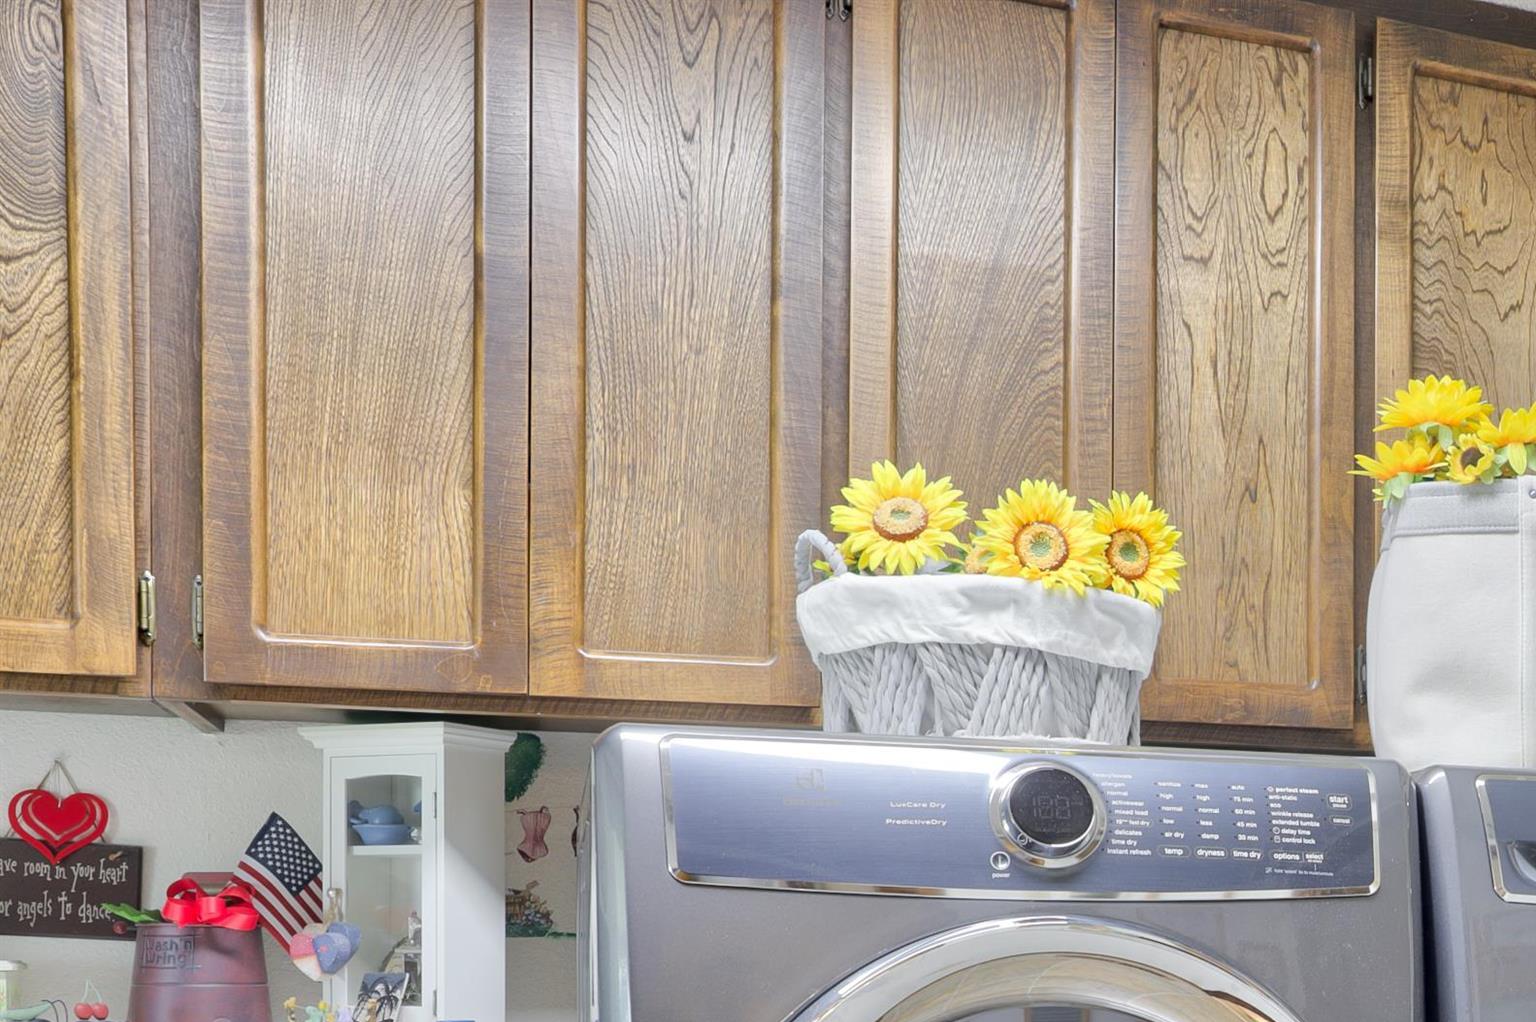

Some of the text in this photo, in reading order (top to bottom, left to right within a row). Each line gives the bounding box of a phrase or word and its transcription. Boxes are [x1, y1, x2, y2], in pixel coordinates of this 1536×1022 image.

[1329, 796, 1349, 804] start
[929, 801, 946, 810] Dry
[886, 818, 948, 827] PredictiveDry
[1164, 848, 1184, 856] temp
[1197, 849, 1225, 857] dryness
[1233, 850, 1261, 859] time dry
[1273, 852, 1300, 861] options
[0, 858, 129, 893] ave room in your heart
[17, 890, 53, 928] angels
[58, 891, 73, 921] to
